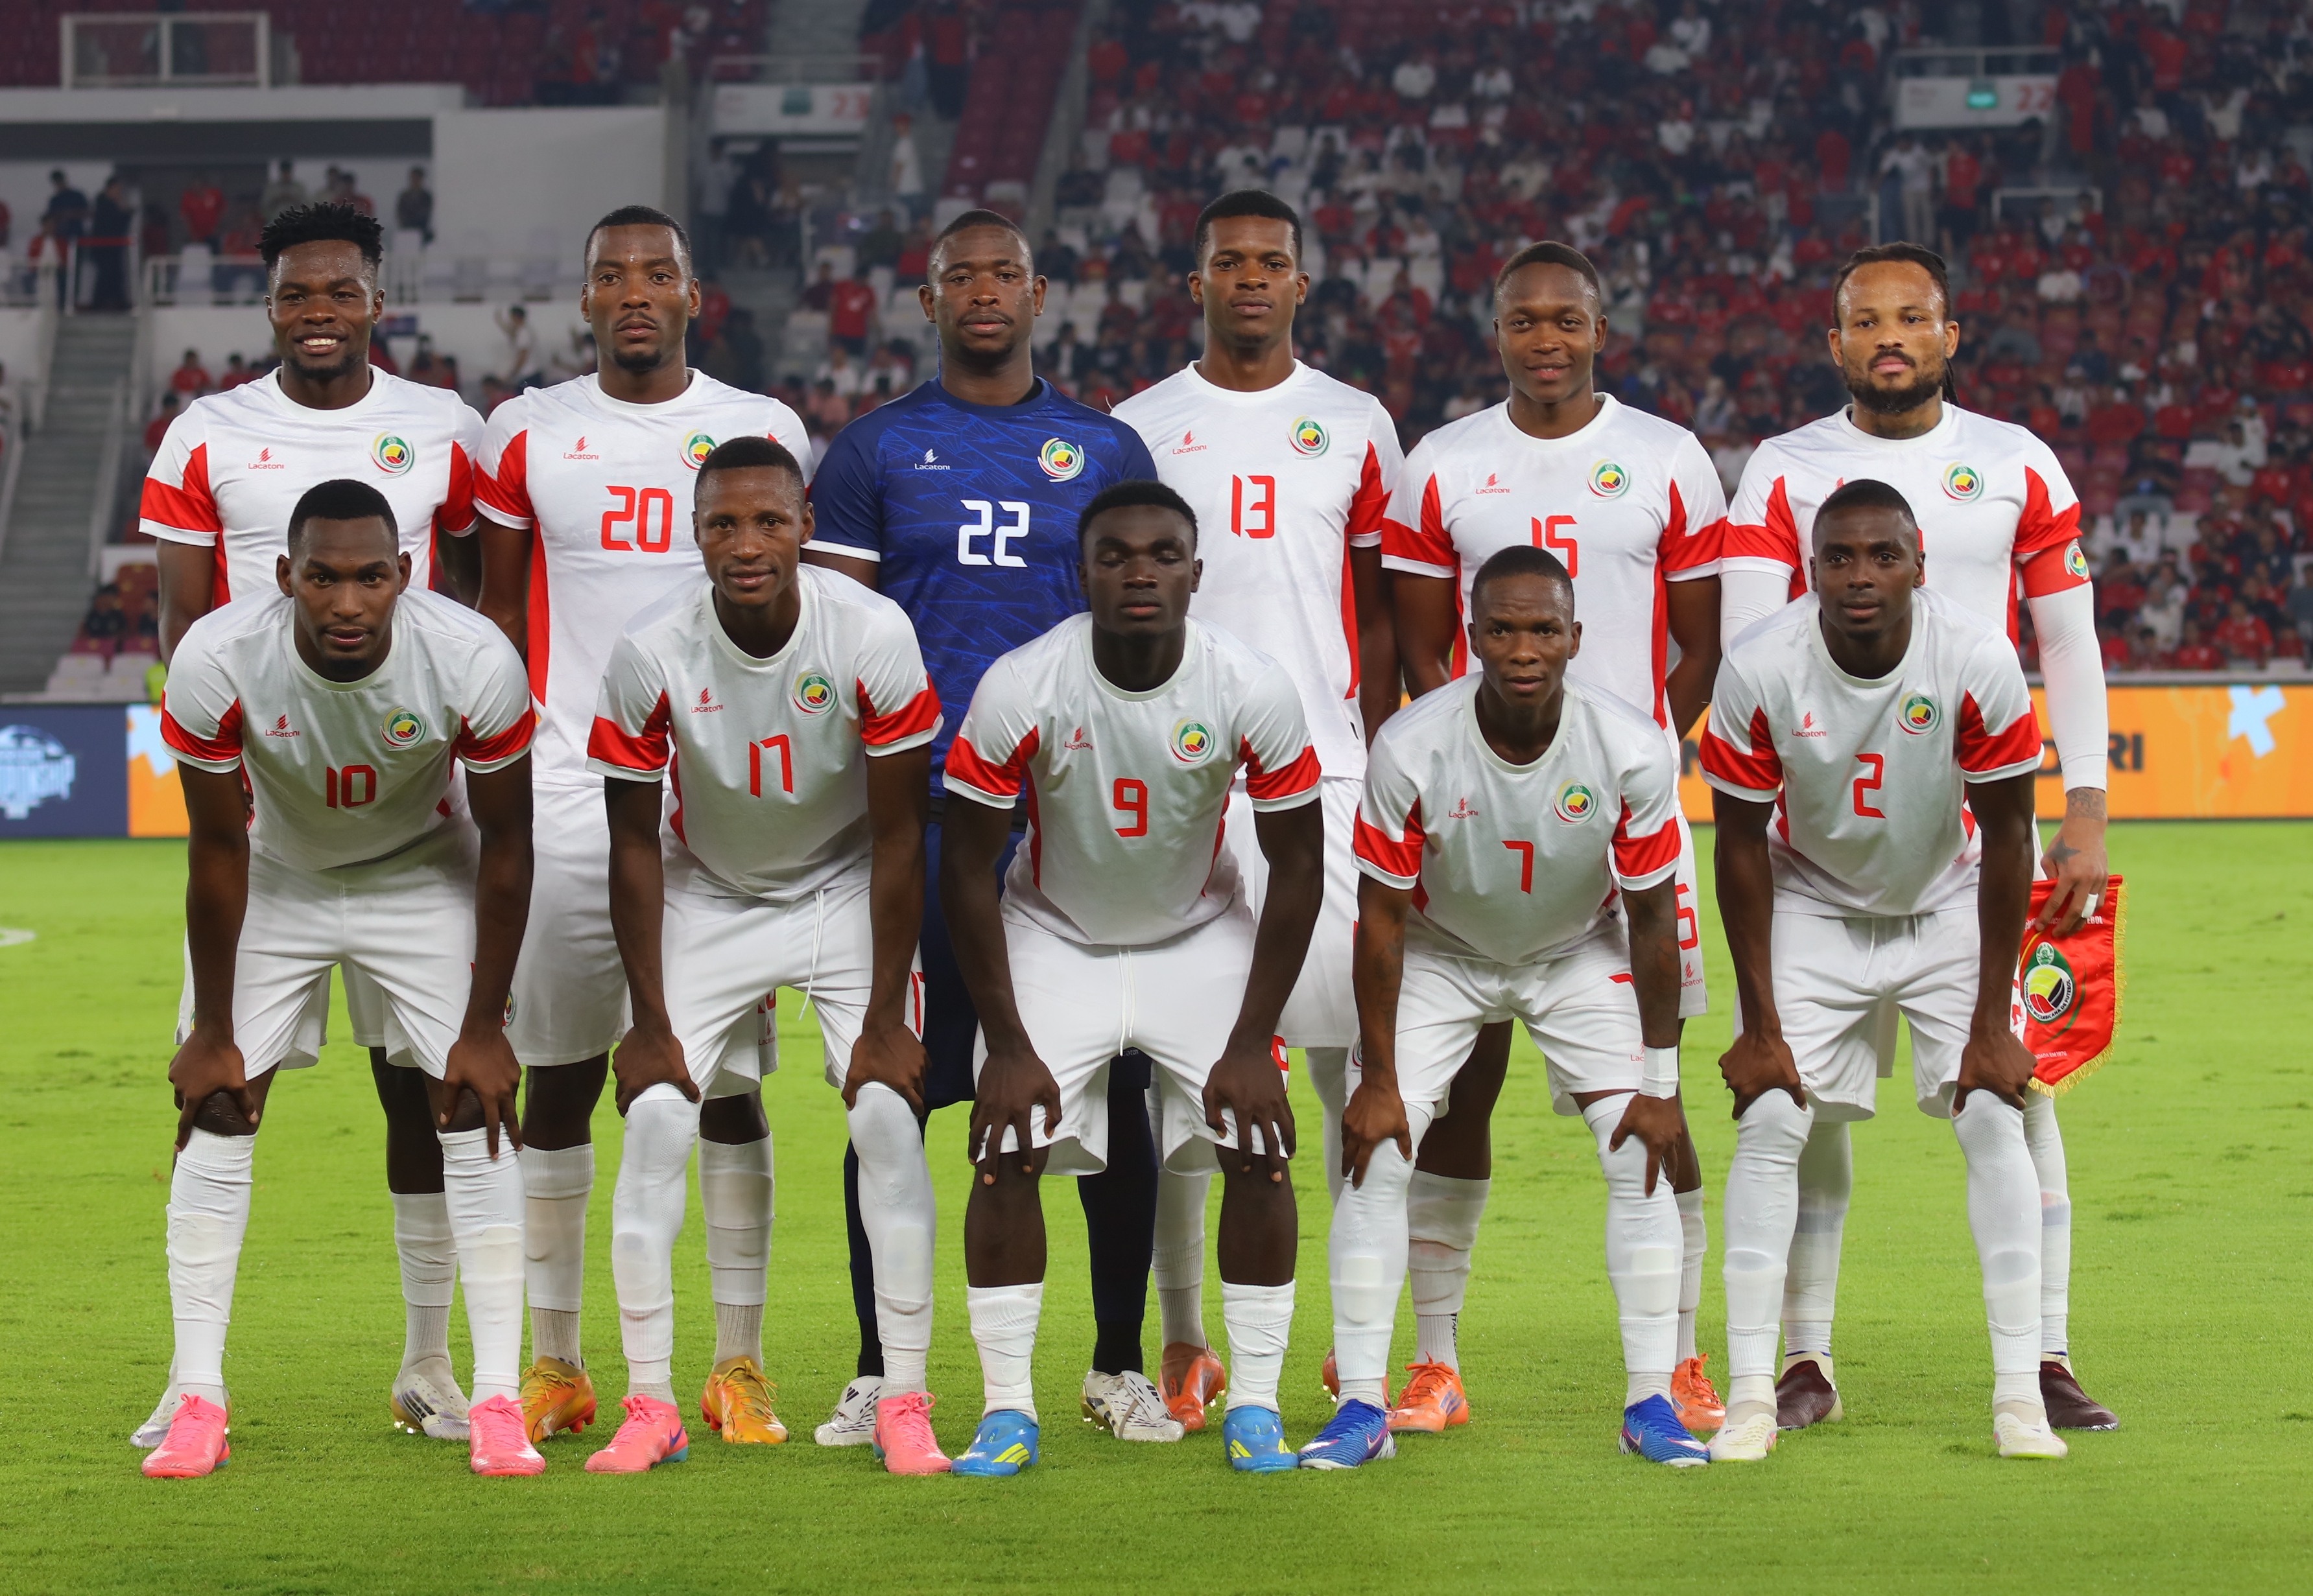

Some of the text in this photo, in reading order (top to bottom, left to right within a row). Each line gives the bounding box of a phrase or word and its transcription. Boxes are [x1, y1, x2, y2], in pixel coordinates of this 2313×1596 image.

[1172, 445, 1207, 456] Lacatoni
[600, 486, 674, 554] 20
[957, 499, 1030, 568] 22
[1231, 475, 1275, 539] 13
[1531, 515, 1578, 579] 15
[265, 729, 301, 738] Lacatoni
[691, 704, 724, 714] Lacatoni
[1792, 729, 1827, 738] Lacatoni
[326, 764, 376, 809] 10
[749, 734, 794, 798] 17
[1853, 753, 1886, 819] 2
[1113, 778, 1148, 838] 9
[1502, 840, 1534, 895] 7
[1674, 883, 1698, 950] 5
[1681, 978, 1703, 987] acaton
